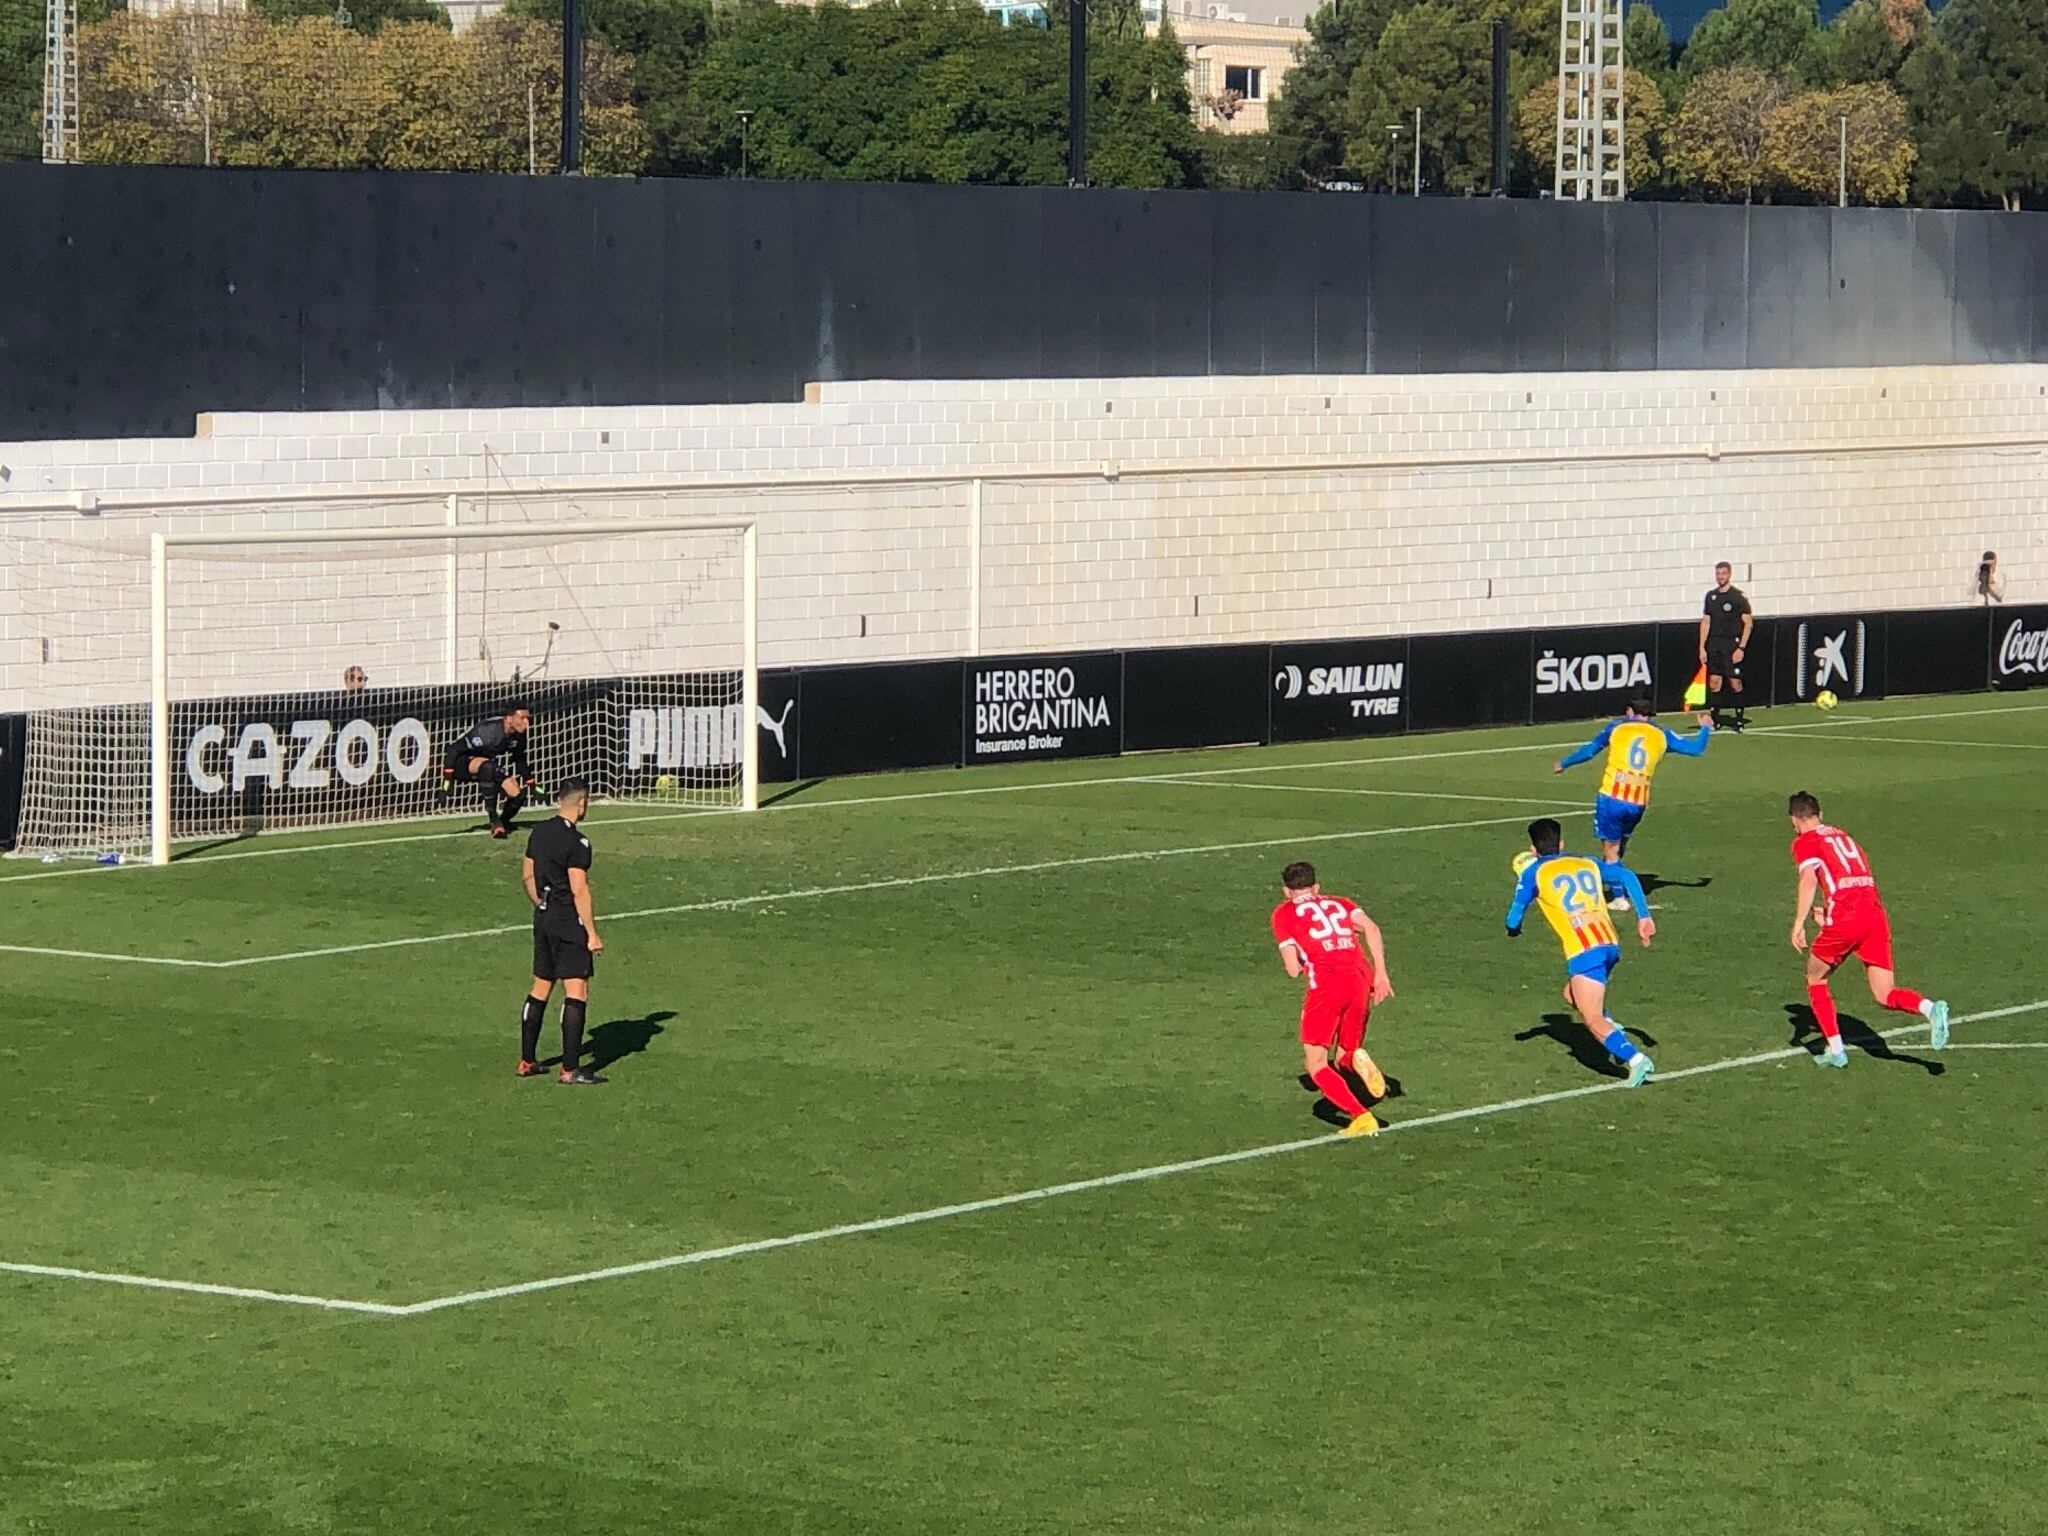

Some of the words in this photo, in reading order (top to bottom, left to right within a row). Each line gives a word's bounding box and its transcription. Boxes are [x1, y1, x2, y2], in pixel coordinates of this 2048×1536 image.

[975, 666, 1075, 702] HERRERO
[1307, 662, 1404, 695] SAILUN
[1536, 649, 1652, 694] ŠKODA
[975, 695, 1111, 734] BRIGANTINA
[1350, 697, 1400, 717] TYRE
[186, 717, 431, 793] CAZOO
[628, 703, 744, 770] PUMA
[975, 738, 1026, 754] Insurance
[1028, 734, 1064, 750] Broker
[1629, 736, 1646, 770] 6
[1824, 836, 1867, 875] 14
[1553, 869, 1600, 914] 29
[1296, 899, 1352, 939] 32
